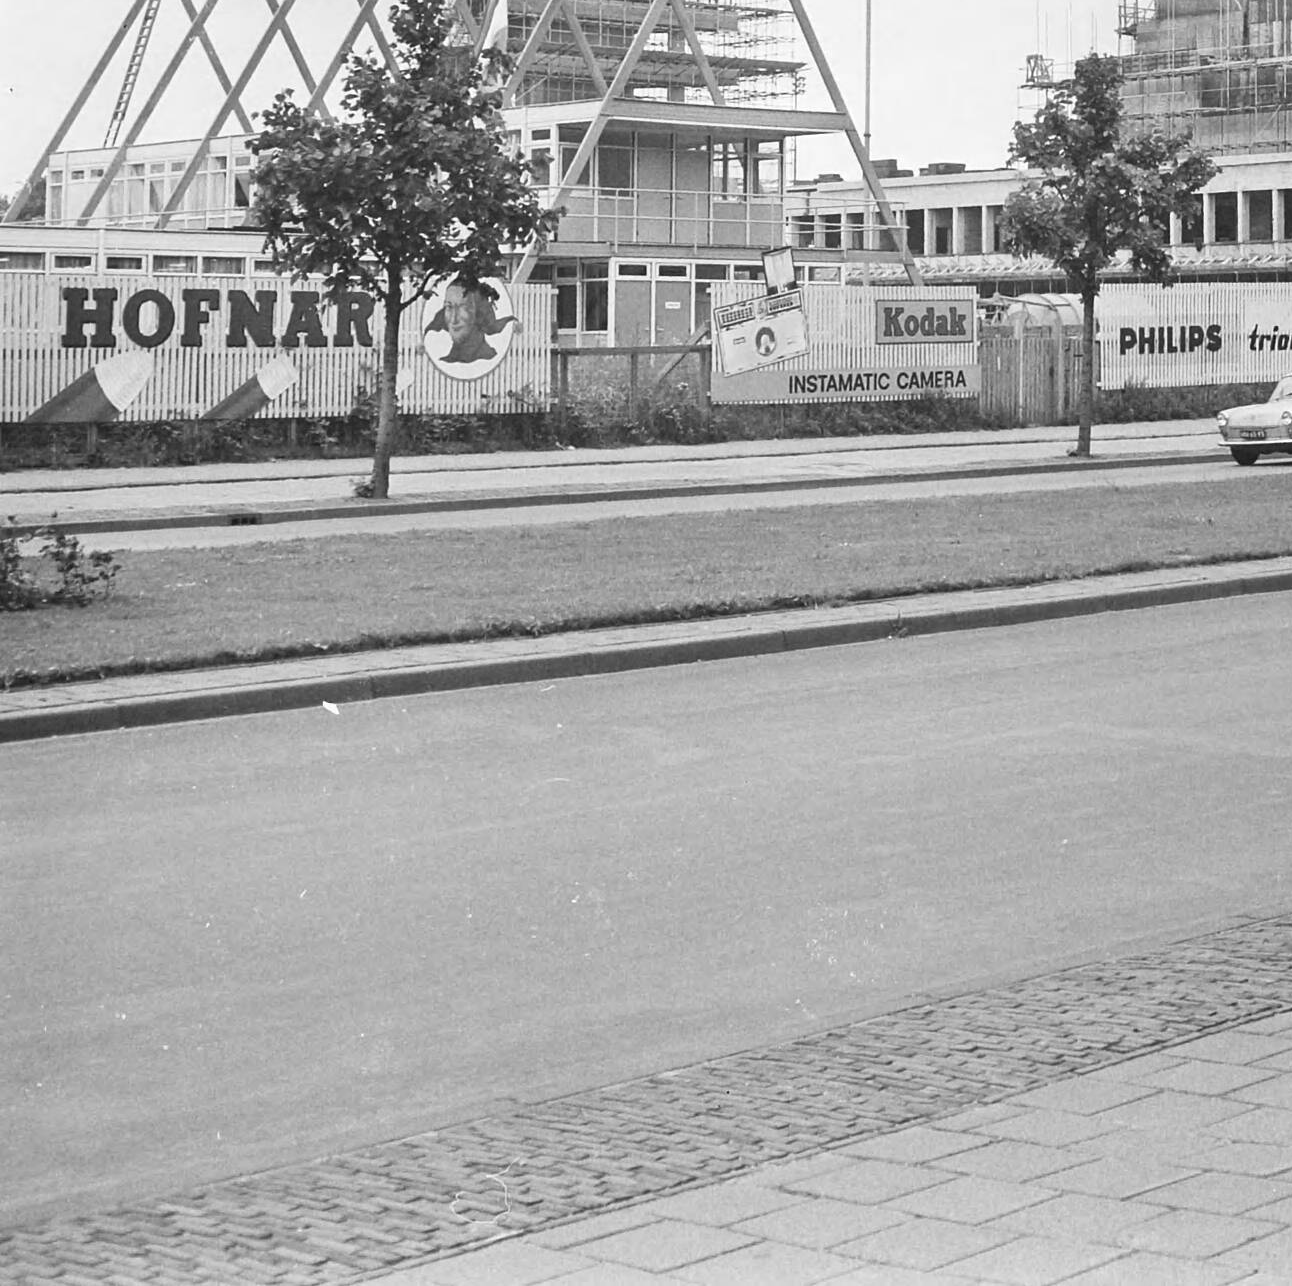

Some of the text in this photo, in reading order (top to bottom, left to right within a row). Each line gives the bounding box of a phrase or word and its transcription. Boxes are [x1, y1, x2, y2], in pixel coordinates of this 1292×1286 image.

[61, 287, 375, 348] HOFNAR
[883, 307, 966, 337] Kodak
[1119, 324, 1222, 356] PHILIPS
[789, 370, 967, 394] INSTAMATIC CAMERA
